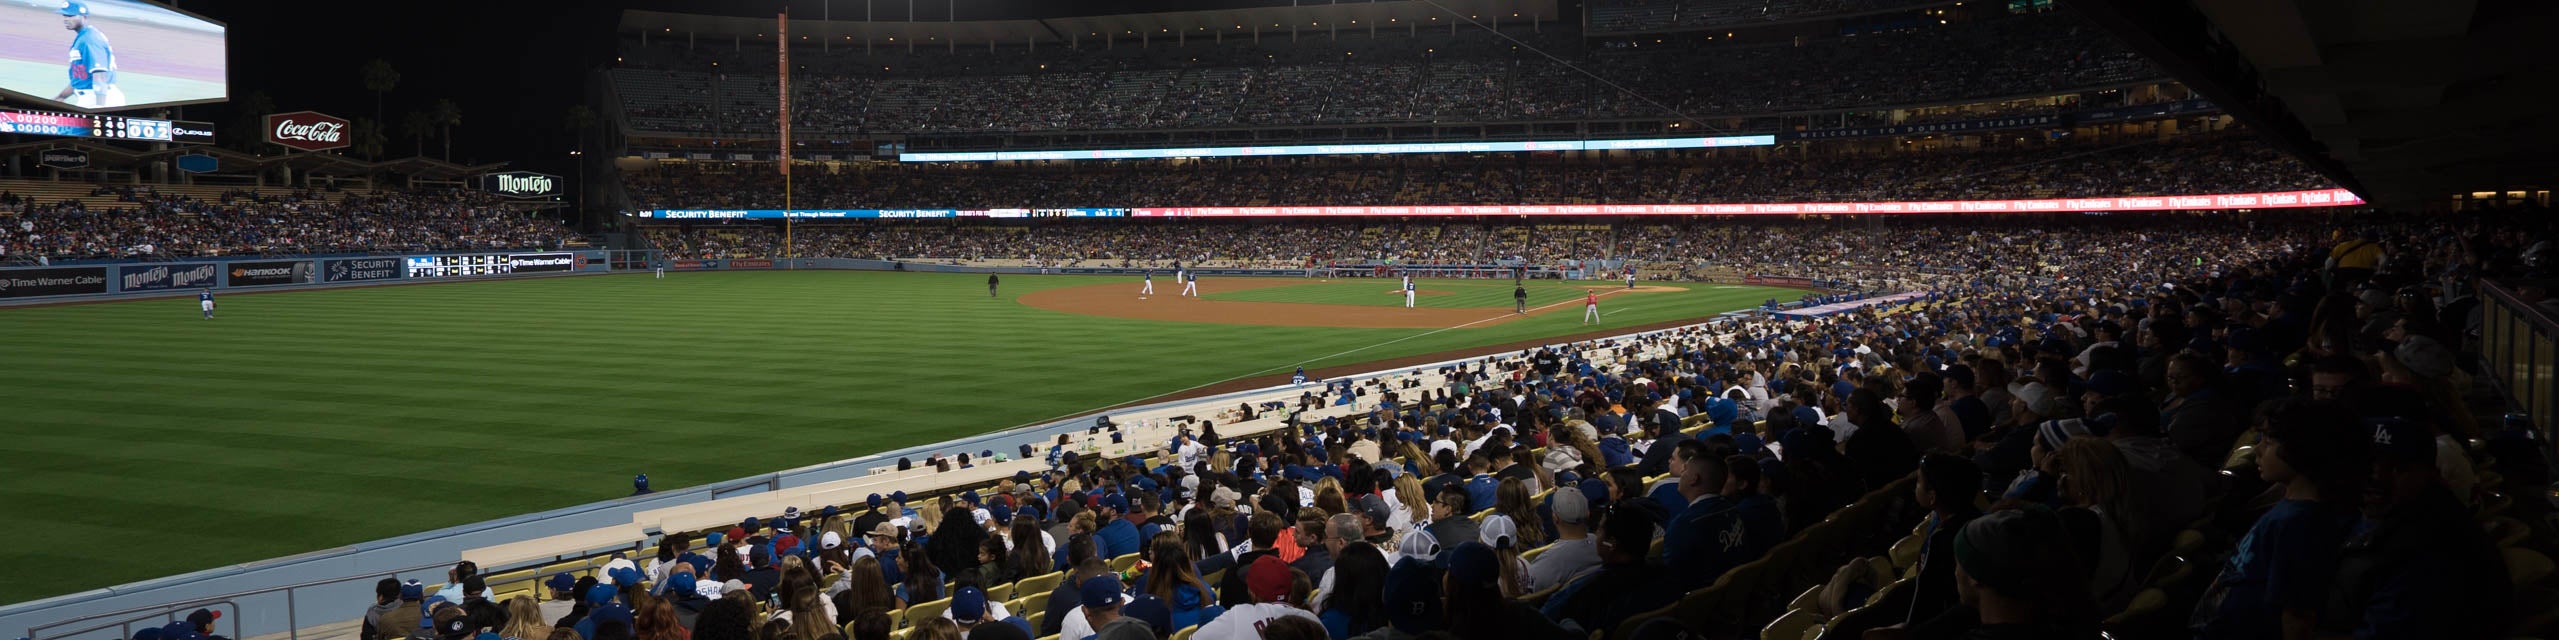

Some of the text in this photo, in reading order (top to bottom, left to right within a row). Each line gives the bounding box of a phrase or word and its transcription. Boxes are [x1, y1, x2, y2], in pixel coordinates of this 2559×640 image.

[276, 119, 343, 142] Coca-Cola
[1800, 129, 1868, 138] WELCOME
[1907, 123, 1966, 133] DODGER
[1979, 116, 2048, 128] STADIUM
[497, 174, 552, 194] Montejo
[2169, 197, 2211, 208] Fly Emirates
[2217, 196, 2256, 207] Fly Emirates
[2262, 195, 2297, 206] Fly Emirates
[2301, 192, 2310, 205] Fly
[2310, 192, 2330, 203] Emirates
[1703, 205, 1715, 213] Fly
[1753, 205, 1766, 213] Fly
[1804, 204, 1817, 212] Fly
[1856, 204, 1869, 212] Fly
[1909, 203, 1921, 212] Fly
[1960, 202, 2006, 211] Fly Emirates
[2014, 201, 2059, 210] Fly Emirates
[2067, 200, 2111, 210] Fly Emirates
[2118, 199, 2162, 209] Fly Emirates
[666, 210, 745, 218] SECURITY BENEFIT
[879, 210, 948, 218] SECURITY BENEFIT
[1556, 206, 1567, 214] Fly
[351, 260, 396, 269] SECURITY
[124, 266, 168, 289] Montejo
[172, 264, 214, 287] Montejo
[351, 269, 390, 279] BENEFIT
[11, 275, 103, 287] Time Warner Cable
[2374, 424, 2392, 444] LA
[1408, 600, 1424, 616] B
